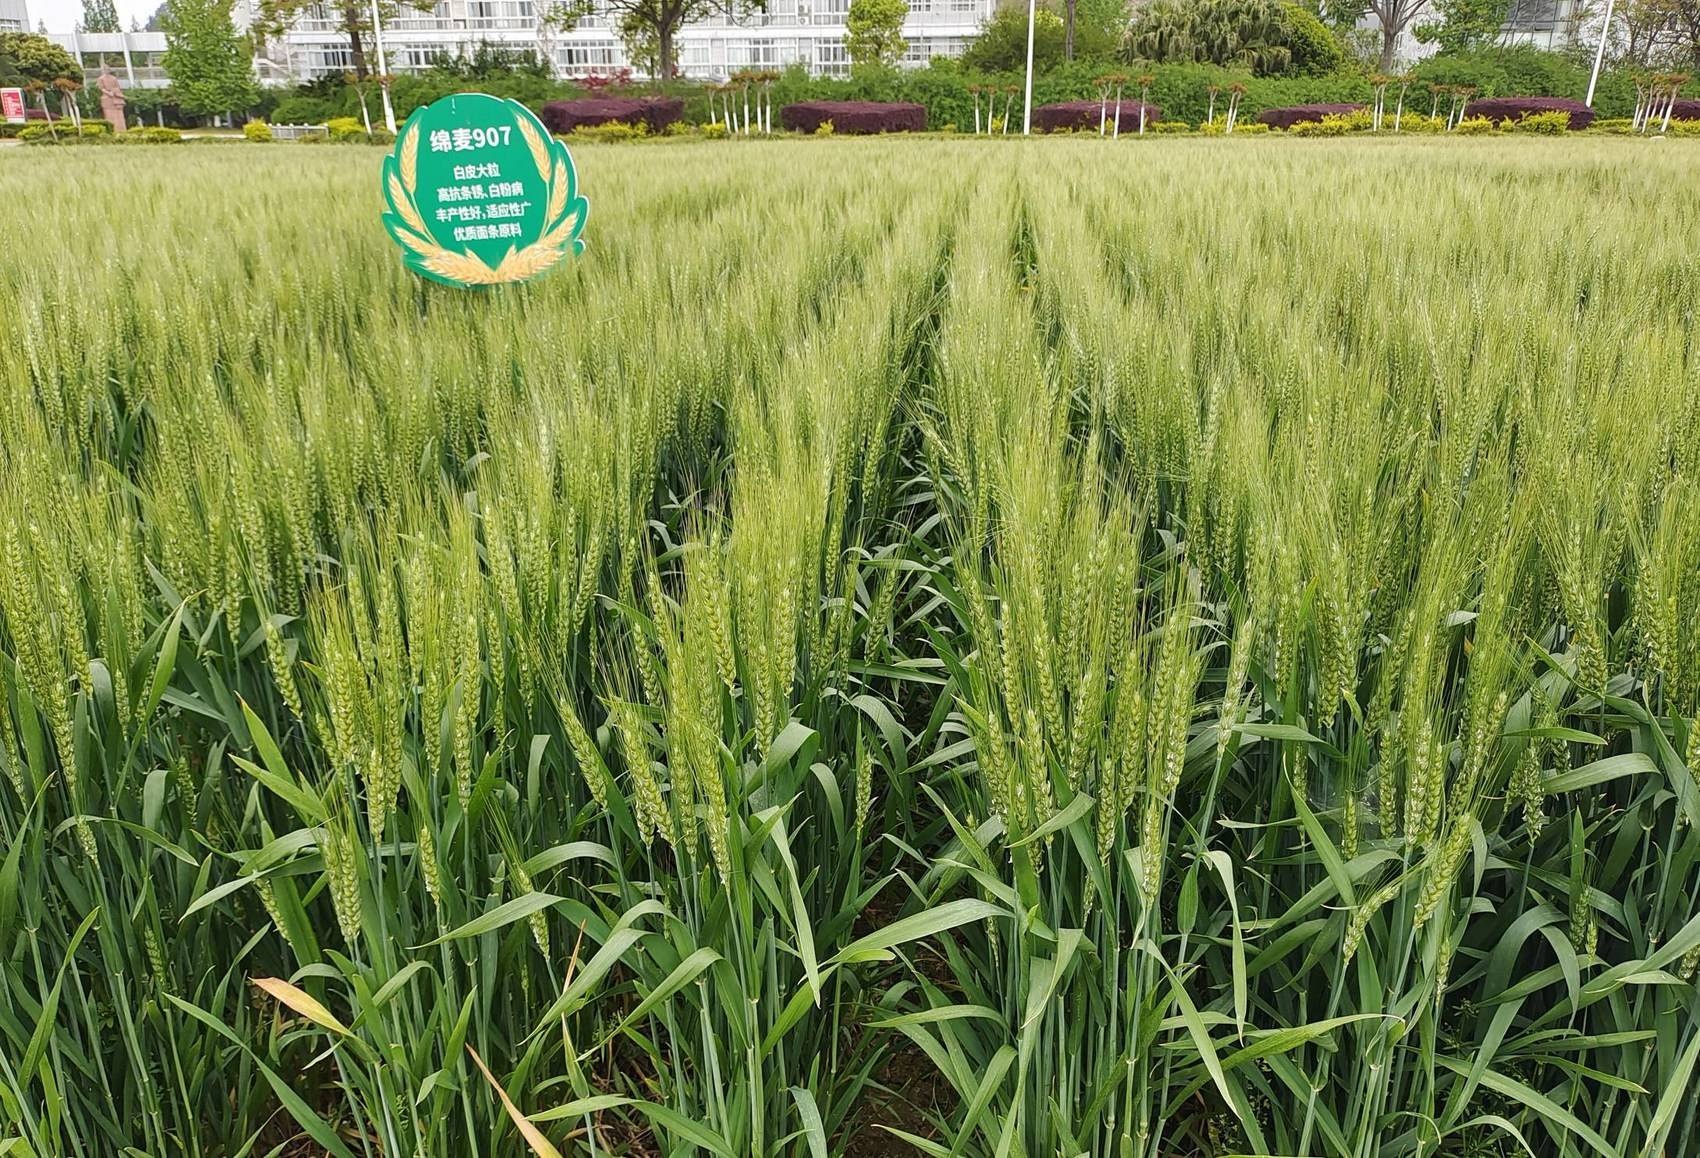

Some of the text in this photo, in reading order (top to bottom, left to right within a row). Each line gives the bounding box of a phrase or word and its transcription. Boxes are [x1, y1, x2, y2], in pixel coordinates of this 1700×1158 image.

[430, 126, 511, 152] 绵麦907
[453, 163, 500, 180] 白皮大粒
[454, 223, 521, 241] 优质面条原料
